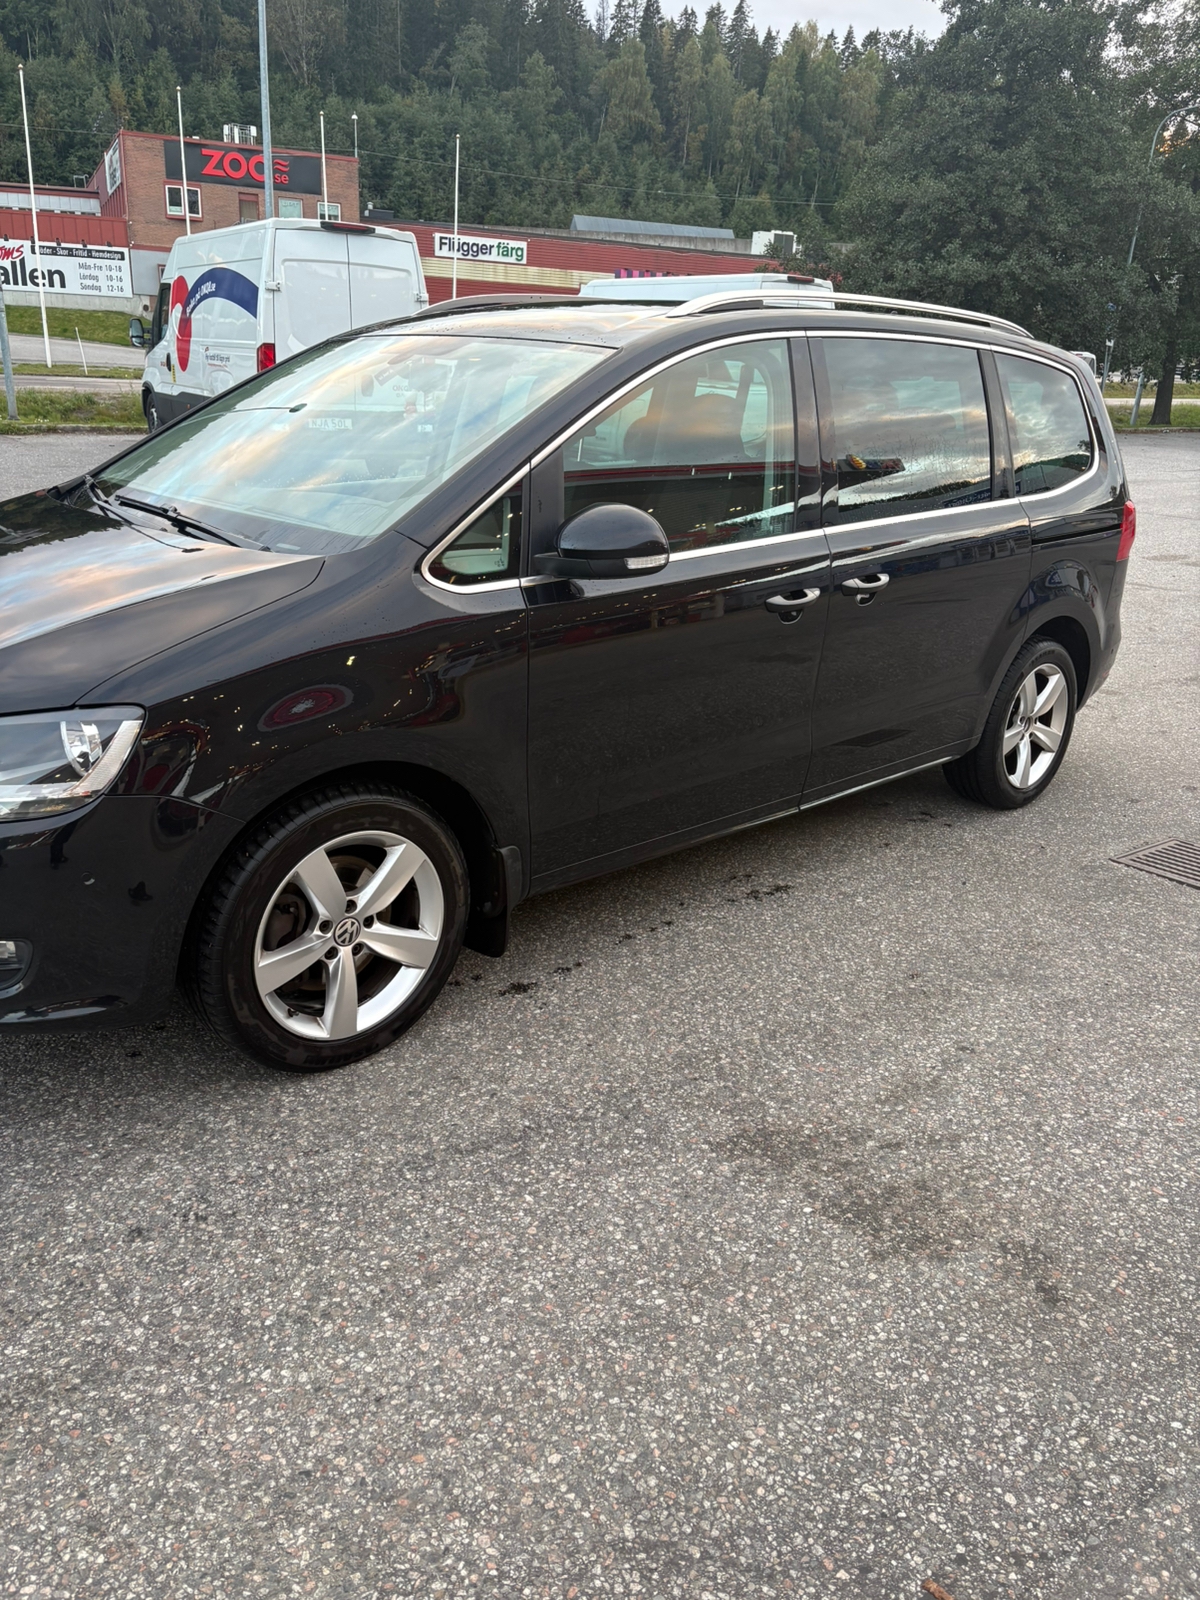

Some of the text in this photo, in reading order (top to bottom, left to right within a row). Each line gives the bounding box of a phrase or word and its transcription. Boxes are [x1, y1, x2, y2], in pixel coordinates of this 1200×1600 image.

[72, 249, 88, 257] Fritid
[439, 236, 524, 262] Flügger färg
[105, 264, 123, 273] 10-18
[79, 273, 124, 283] Lördag 10-16
[107, 284, 125, 293] 12-16
[311, 418, 330, 429] NJA
